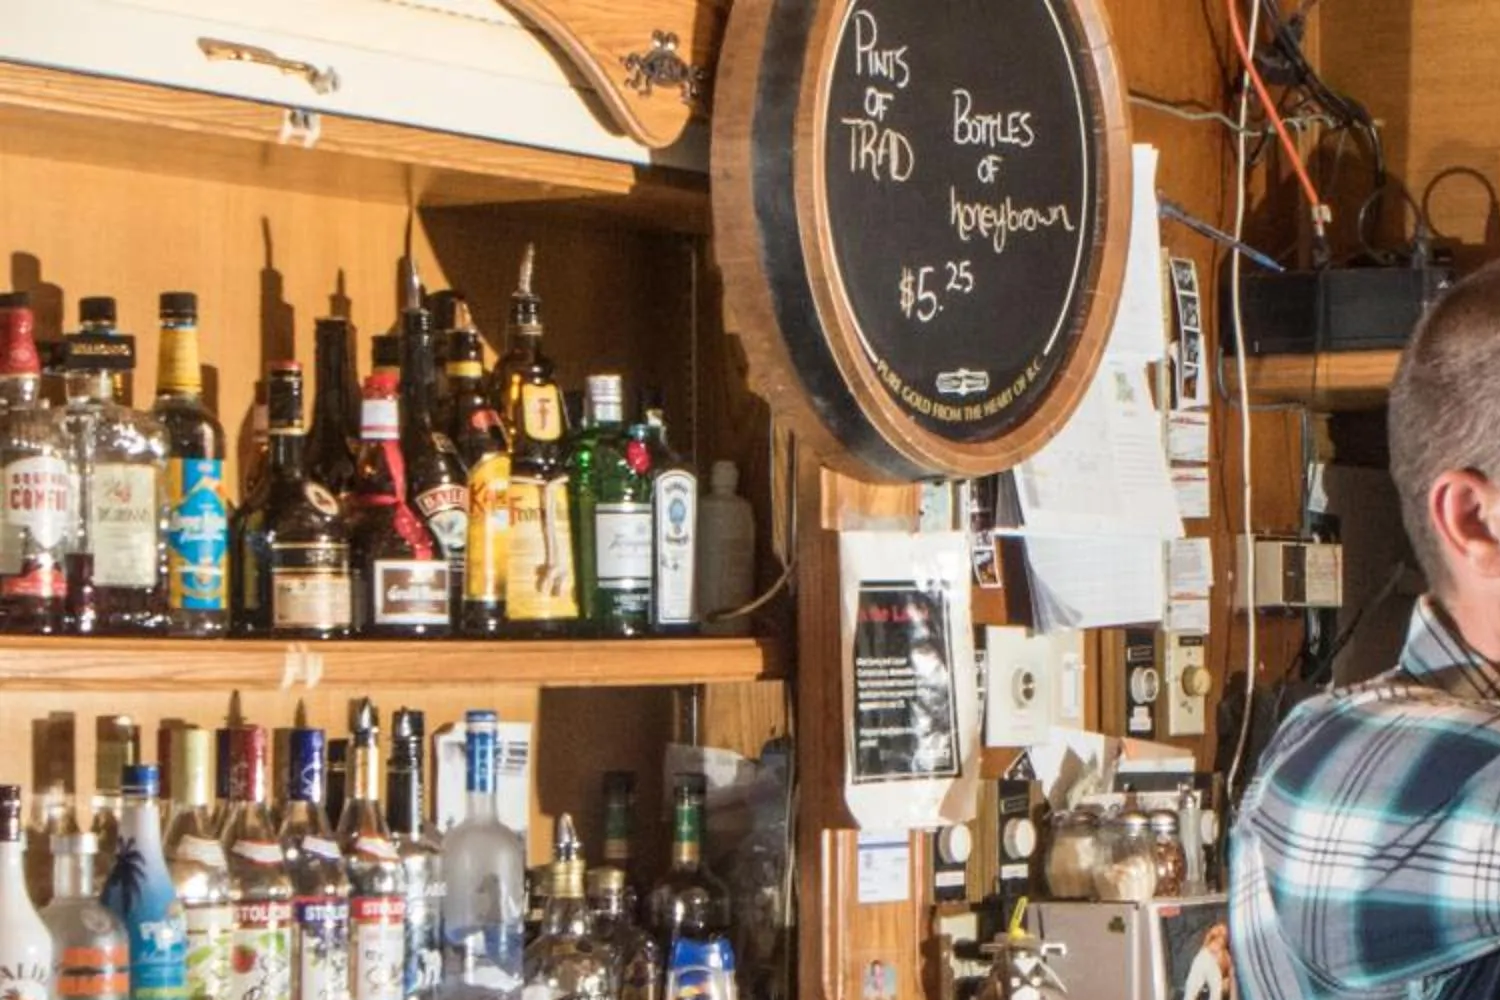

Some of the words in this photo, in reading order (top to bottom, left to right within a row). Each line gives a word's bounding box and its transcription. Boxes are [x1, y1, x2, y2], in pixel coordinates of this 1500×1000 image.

[864, 86, 895, 121] OF
[841, 117, 916, 183] TRAD
[977, 154, 1004, 184] OF
[949, 185, 1076, 254] honeybrown
[877, 358, 902, 395] PURE
[901, 385, 932, 416] GOLD
[932, 404, 963, 422] FROM
[963, 404, 985, 422] THE
[983, 390, 1014, 417] HEART
[1012, 374, 1029, 397] OF
